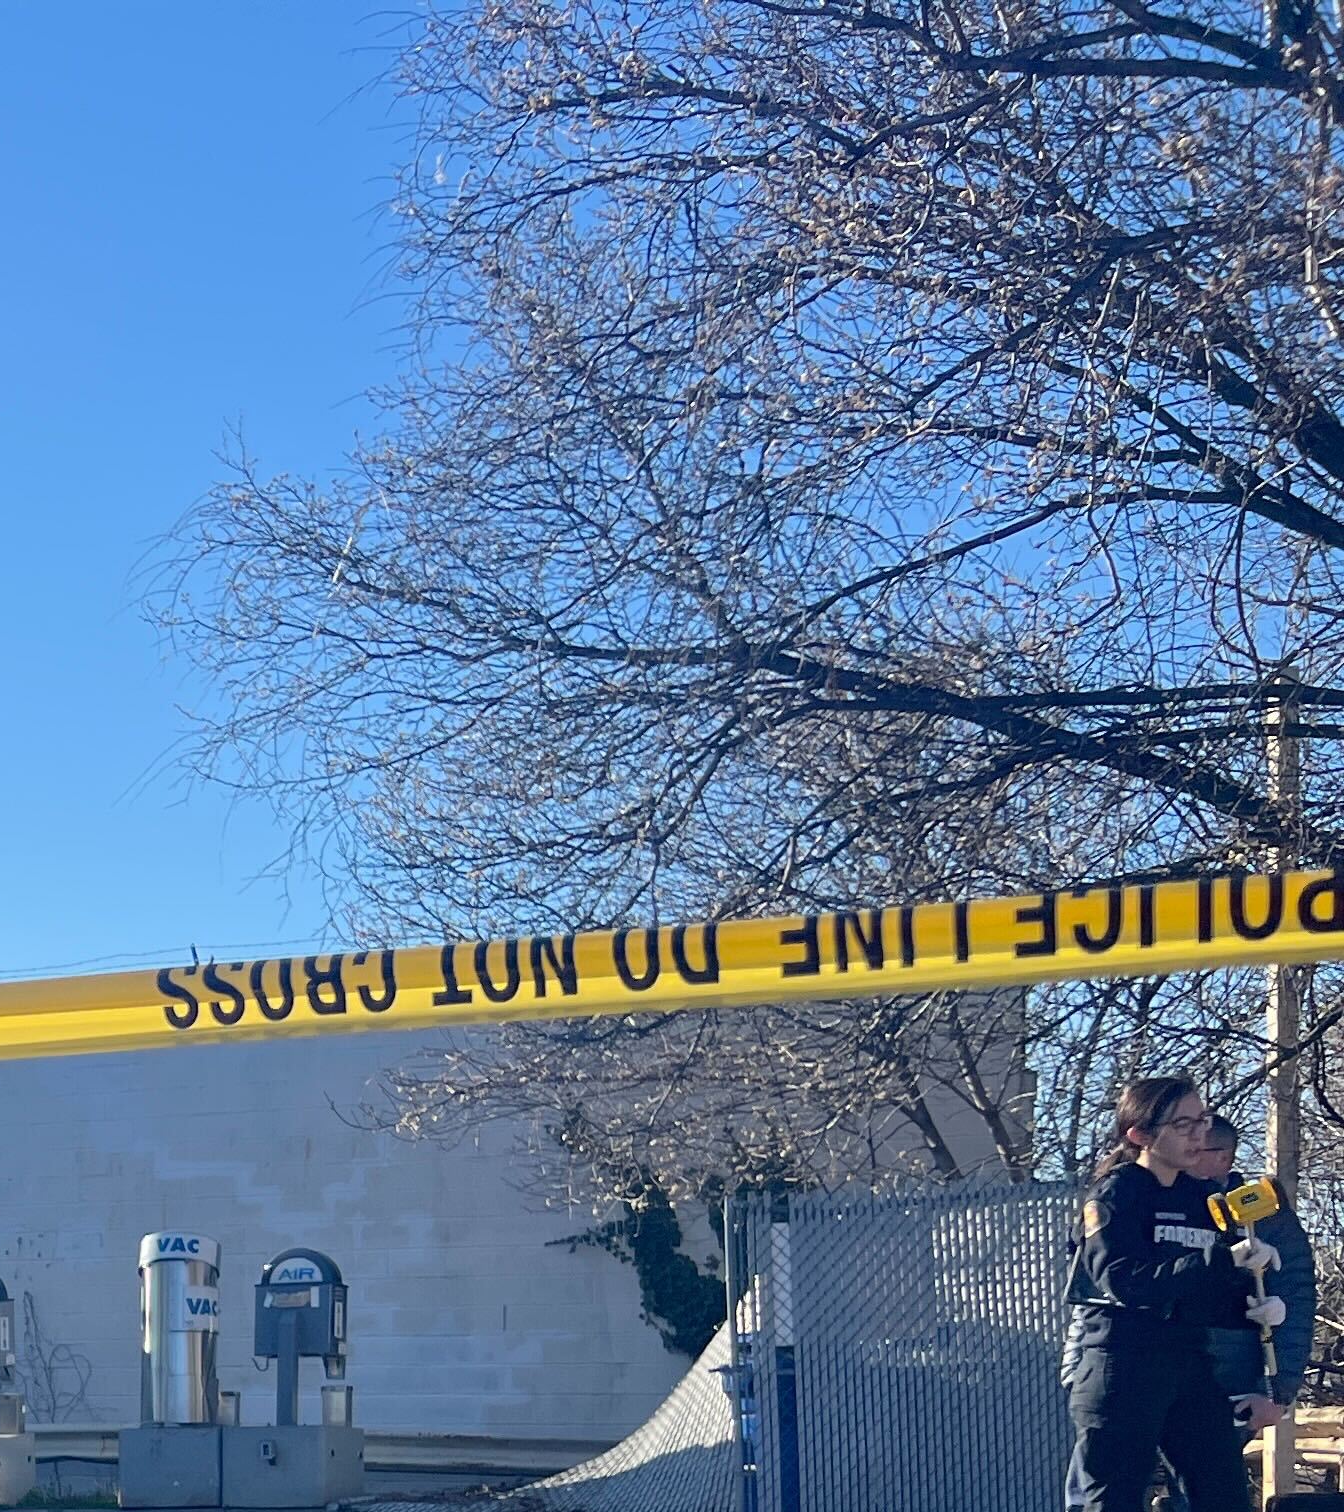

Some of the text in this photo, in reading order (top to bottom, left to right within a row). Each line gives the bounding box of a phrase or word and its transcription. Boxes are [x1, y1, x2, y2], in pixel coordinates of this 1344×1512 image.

[155, 868, 1344, 1029] POLICE LINE DO NOT CROSS
[157, 1236, 200, 1254] VAC
[278, 1268, 315, 1281] AIR
